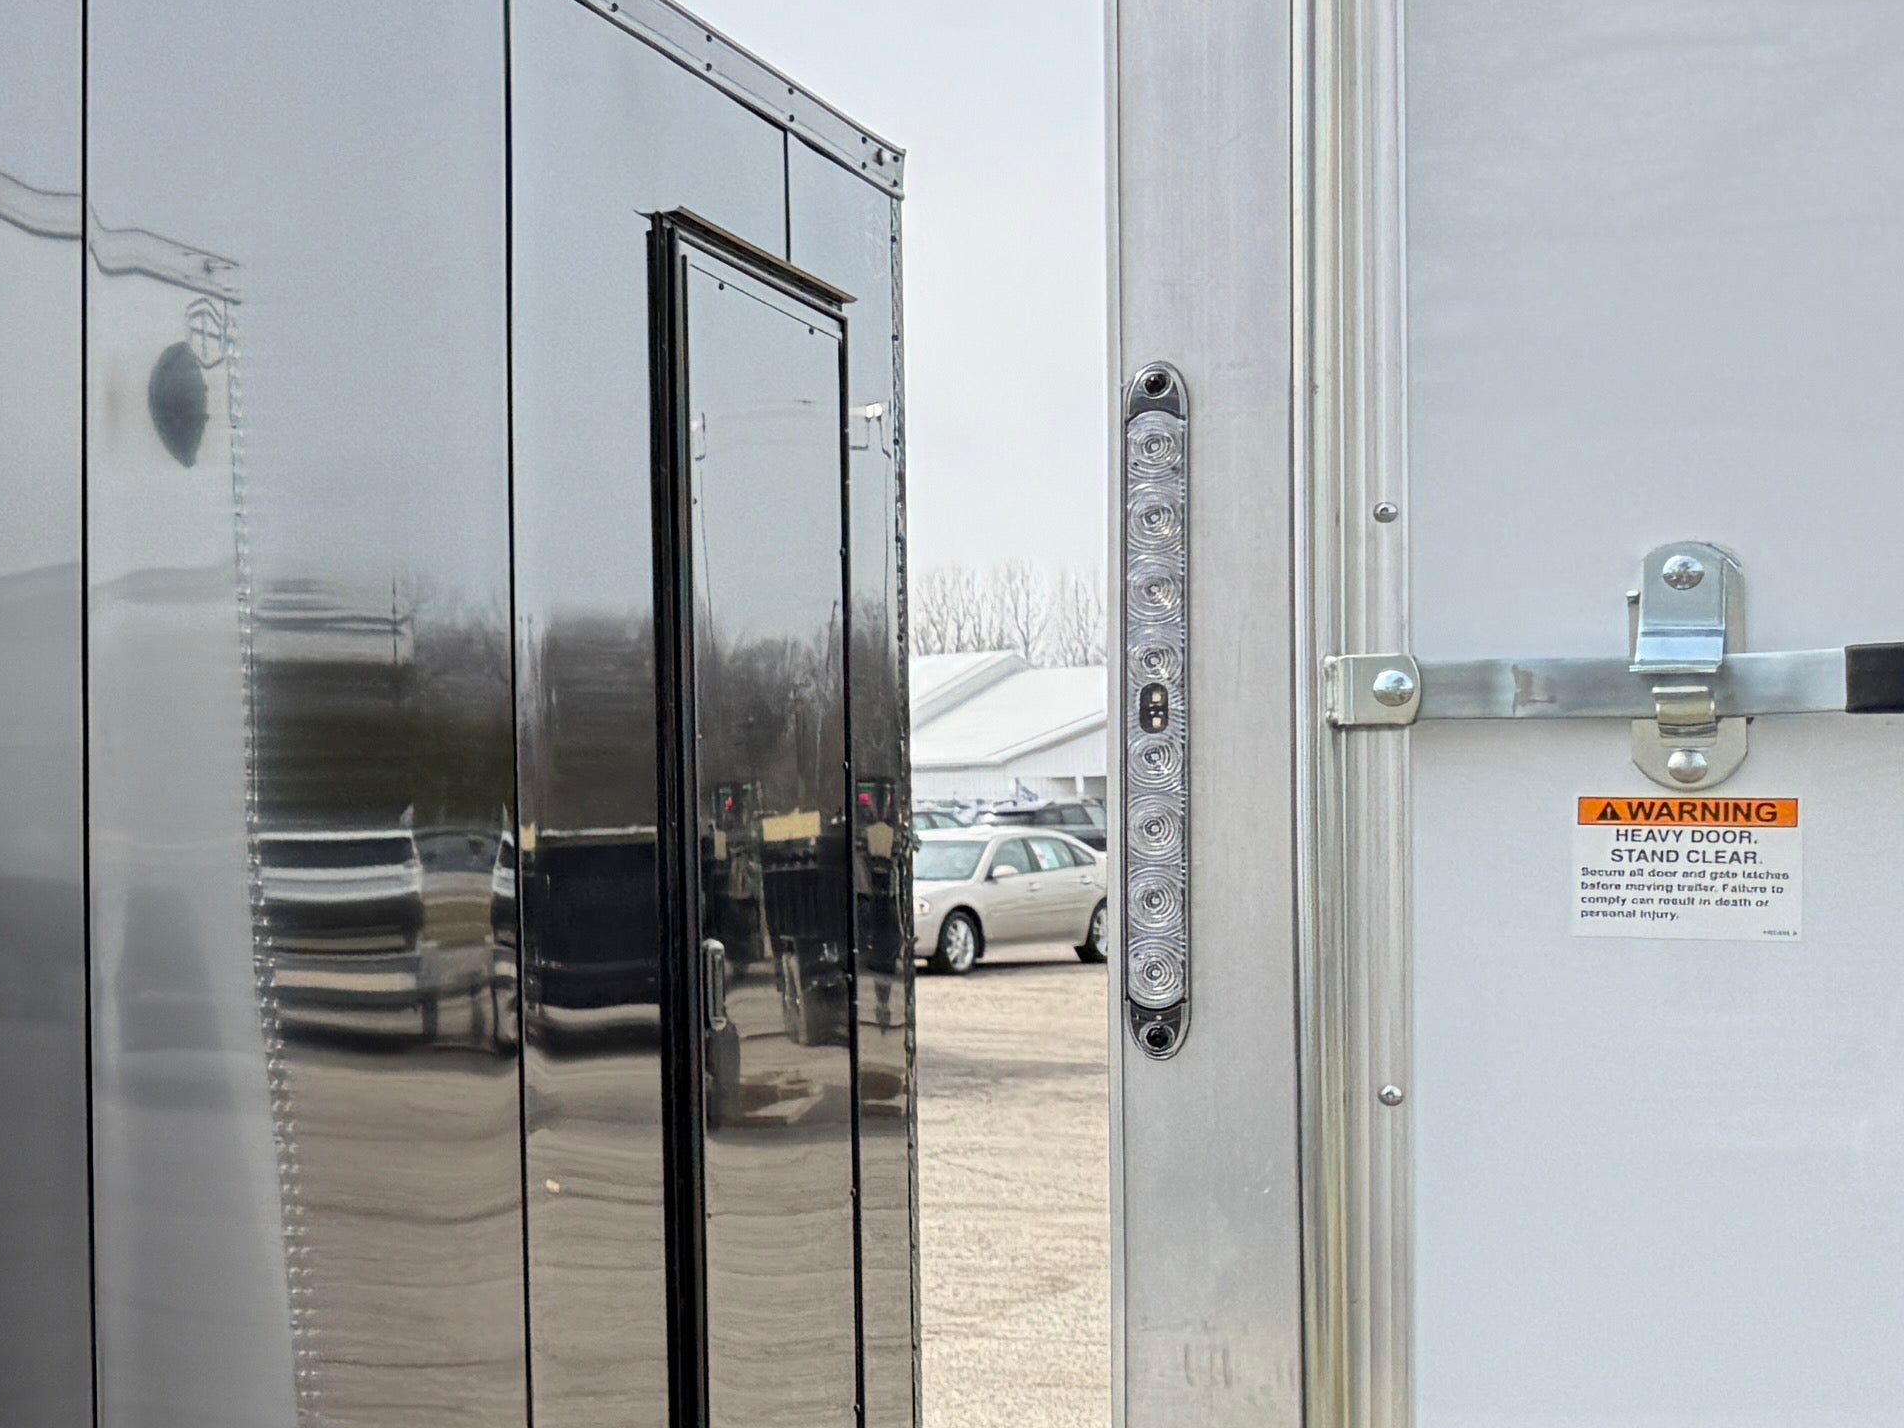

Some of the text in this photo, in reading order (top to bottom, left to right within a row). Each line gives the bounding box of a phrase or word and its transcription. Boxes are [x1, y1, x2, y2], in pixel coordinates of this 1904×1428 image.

[1627, 801, 1778, 823] WARNING
[1615, 828, 1759, 845] HEAVY DOOR.
[1610, 848, 1764, 865] STAND CLEAR.
[1648, 868, 1678, 878] door
[1682, 868, 1706, 879] and
[1625, 882, 1674, 894] moving
[1771, 885, 1784, 894] to
[1581, 895, 1627, 907] comply
[1581, 909, 1636, 919] personal
